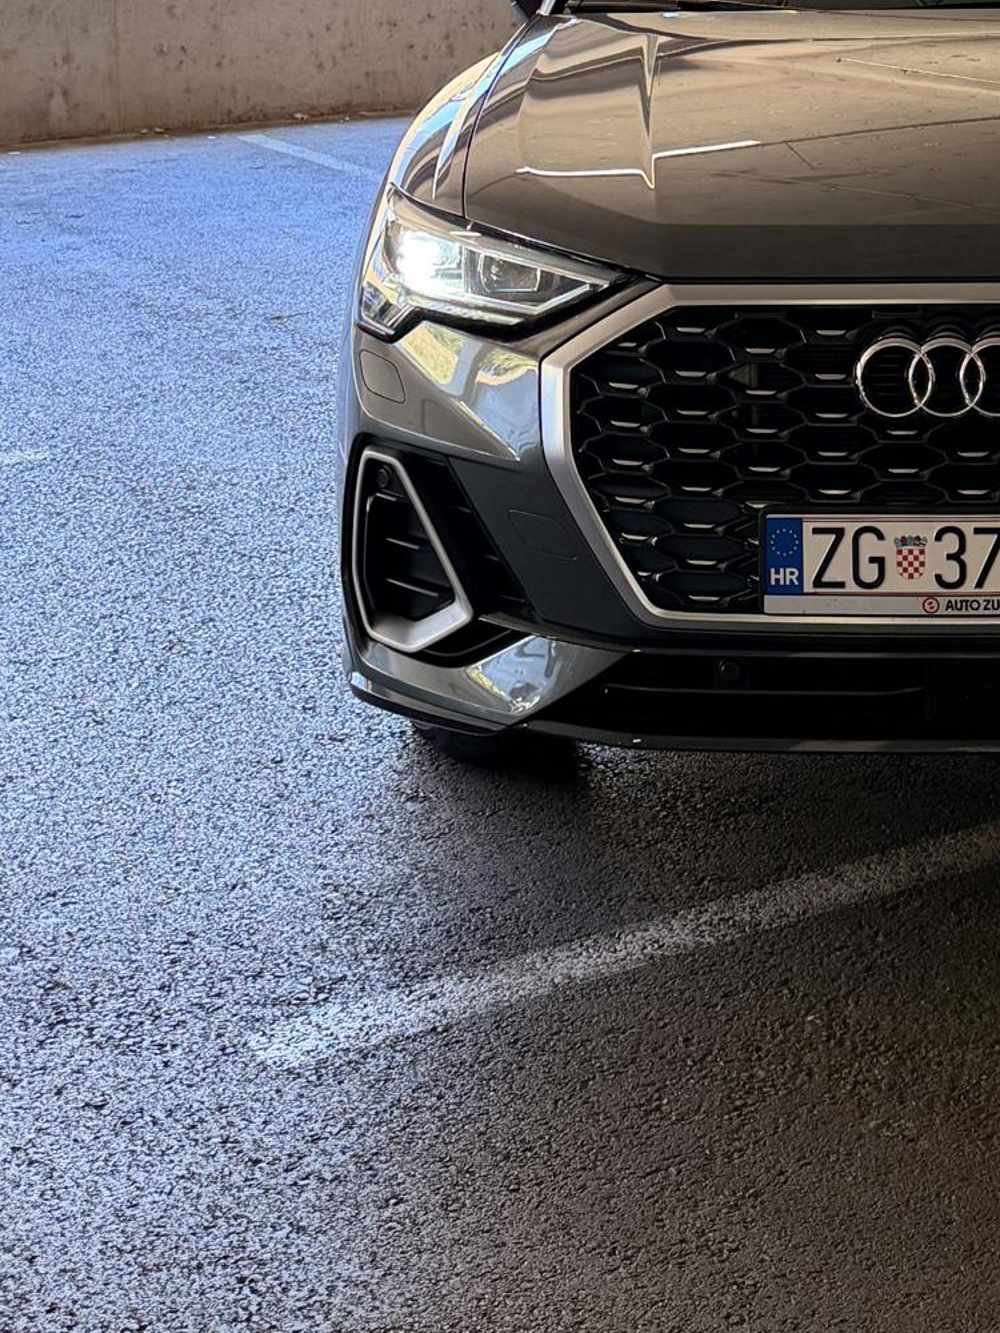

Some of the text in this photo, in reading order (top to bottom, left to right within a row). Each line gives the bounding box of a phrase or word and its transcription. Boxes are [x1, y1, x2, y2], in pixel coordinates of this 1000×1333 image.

[811, 525, 886, 590] ZG
[769, 568, 799, 586] HR
[945, 599, 981, 611] AUTO
